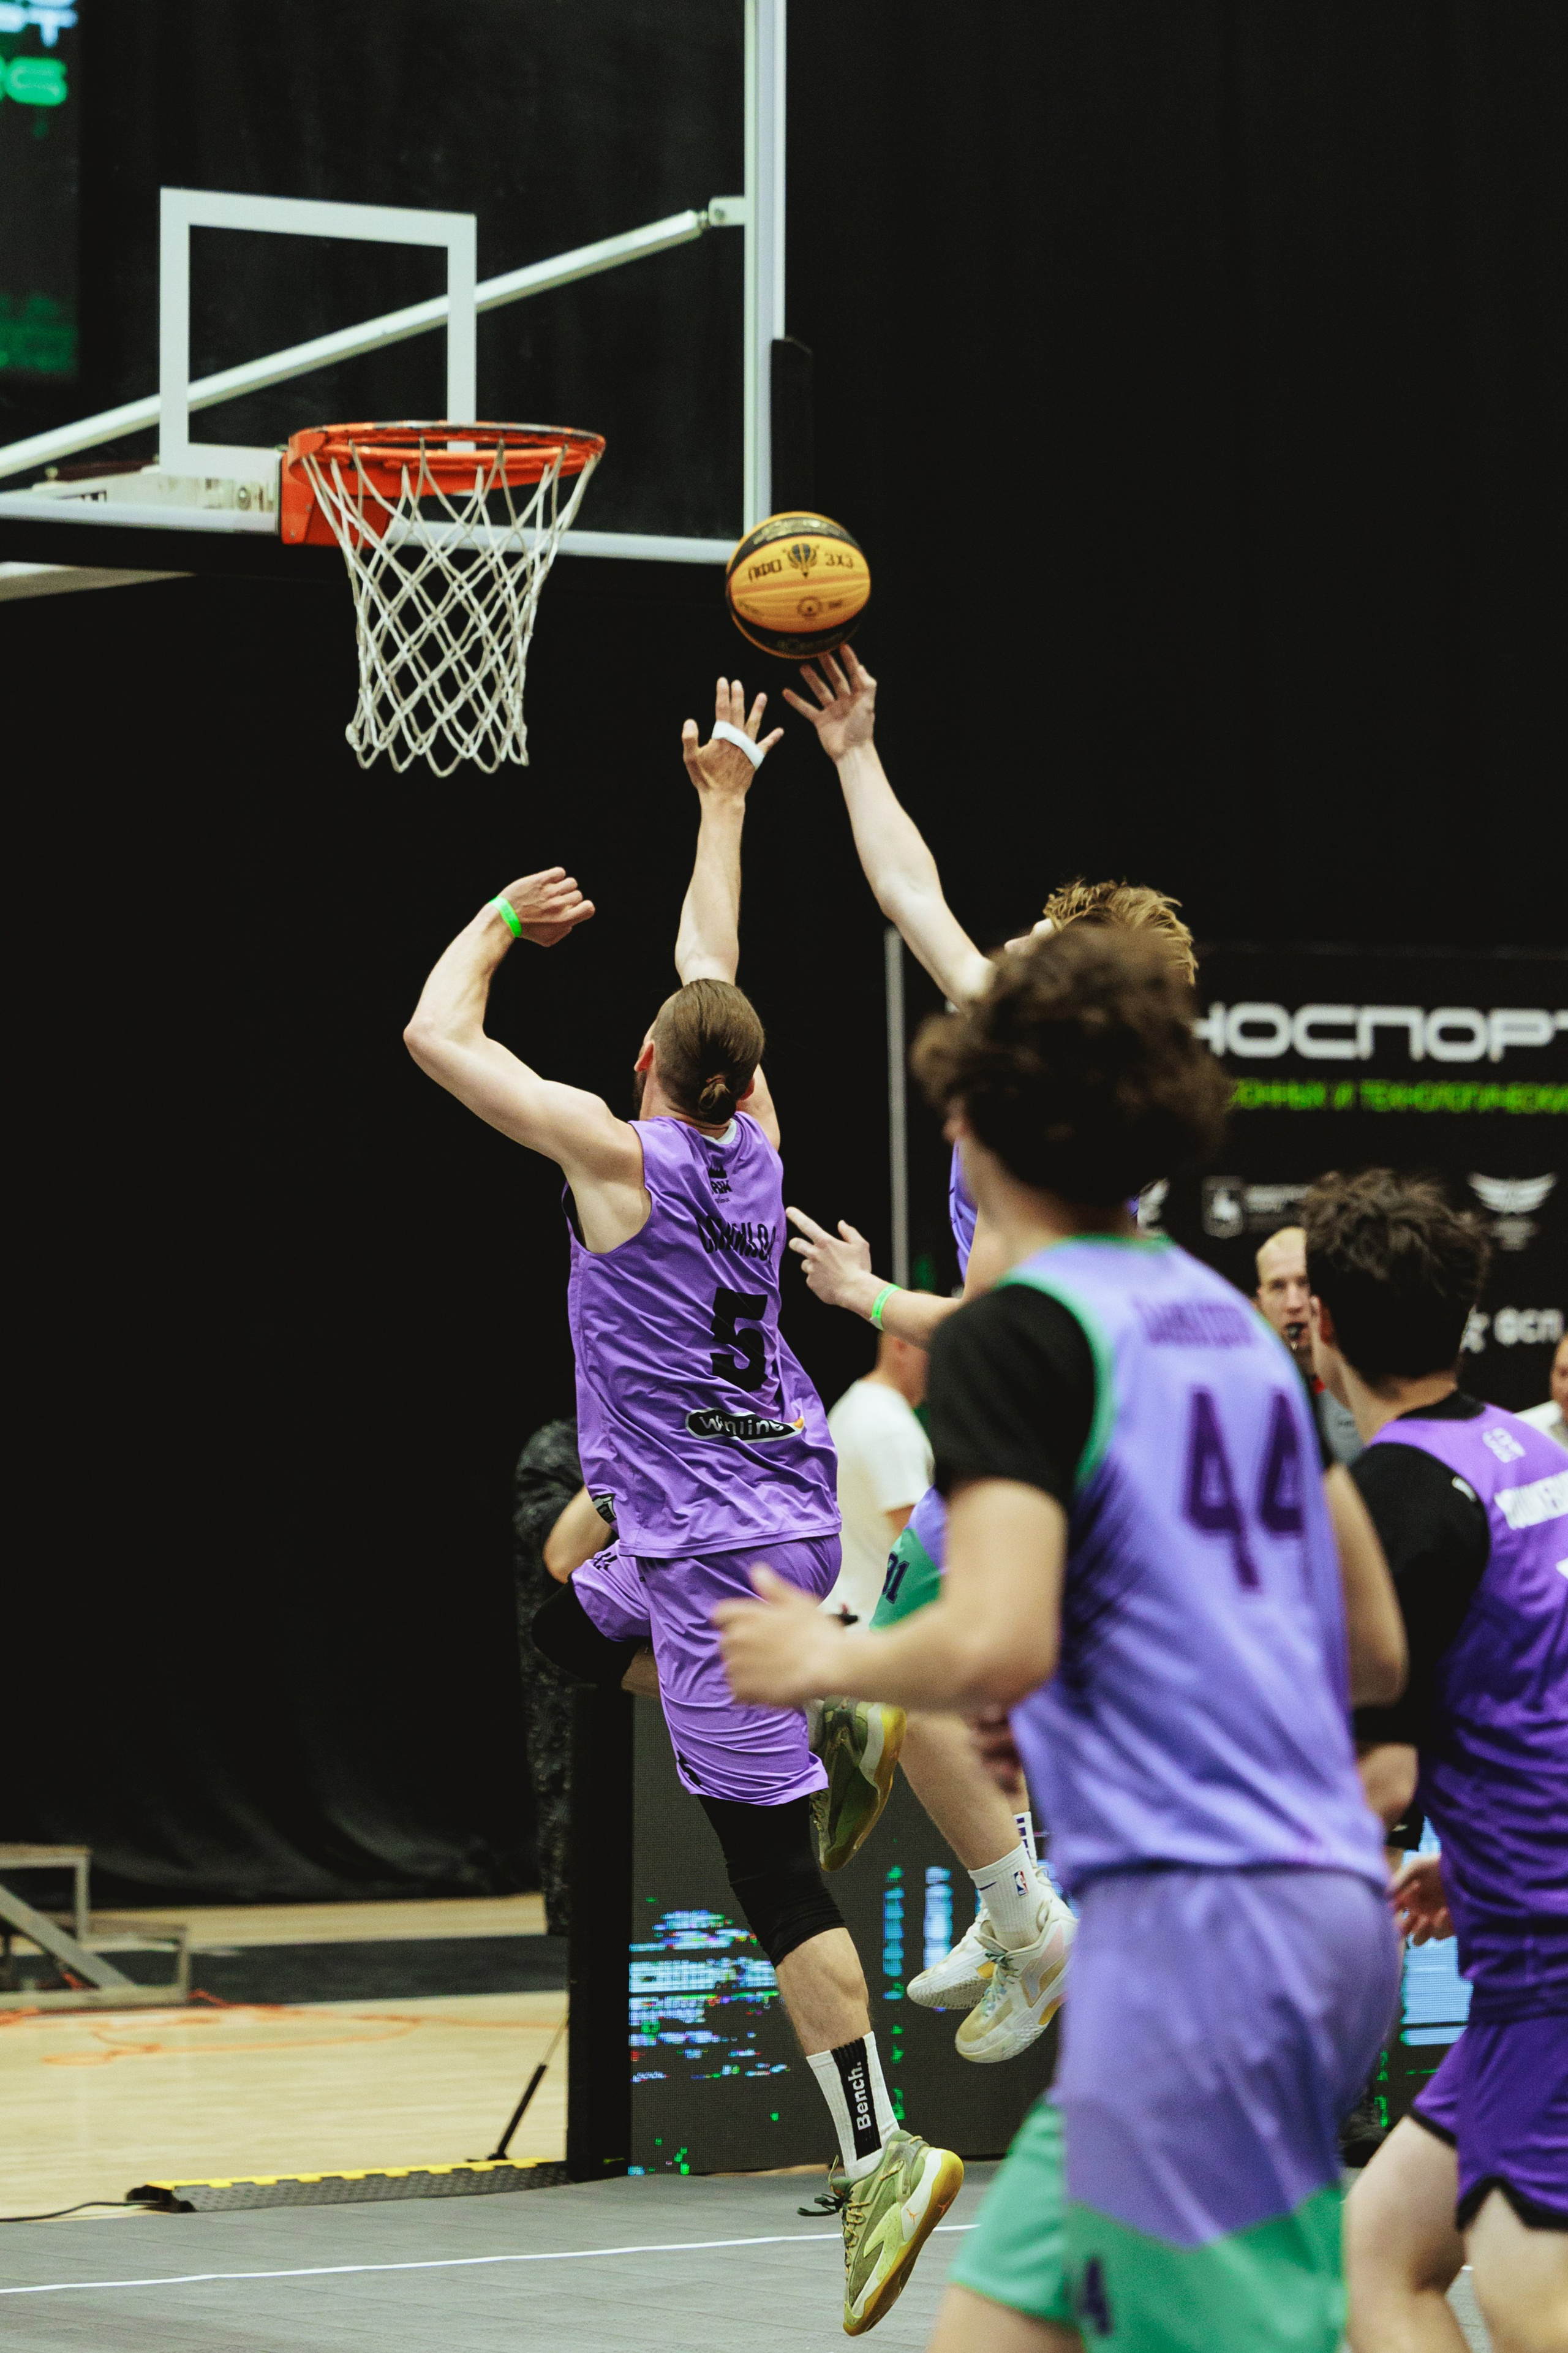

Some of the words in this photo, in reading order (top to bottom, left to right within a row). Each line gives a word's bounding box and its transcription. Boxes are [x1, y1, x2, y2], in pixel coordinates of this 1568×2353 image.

[1191, 1001, 1568, 1063] НОСПОР
[710, 1286, 768, 1392] 5
[848, 2061, 872, 2131] Bench.
